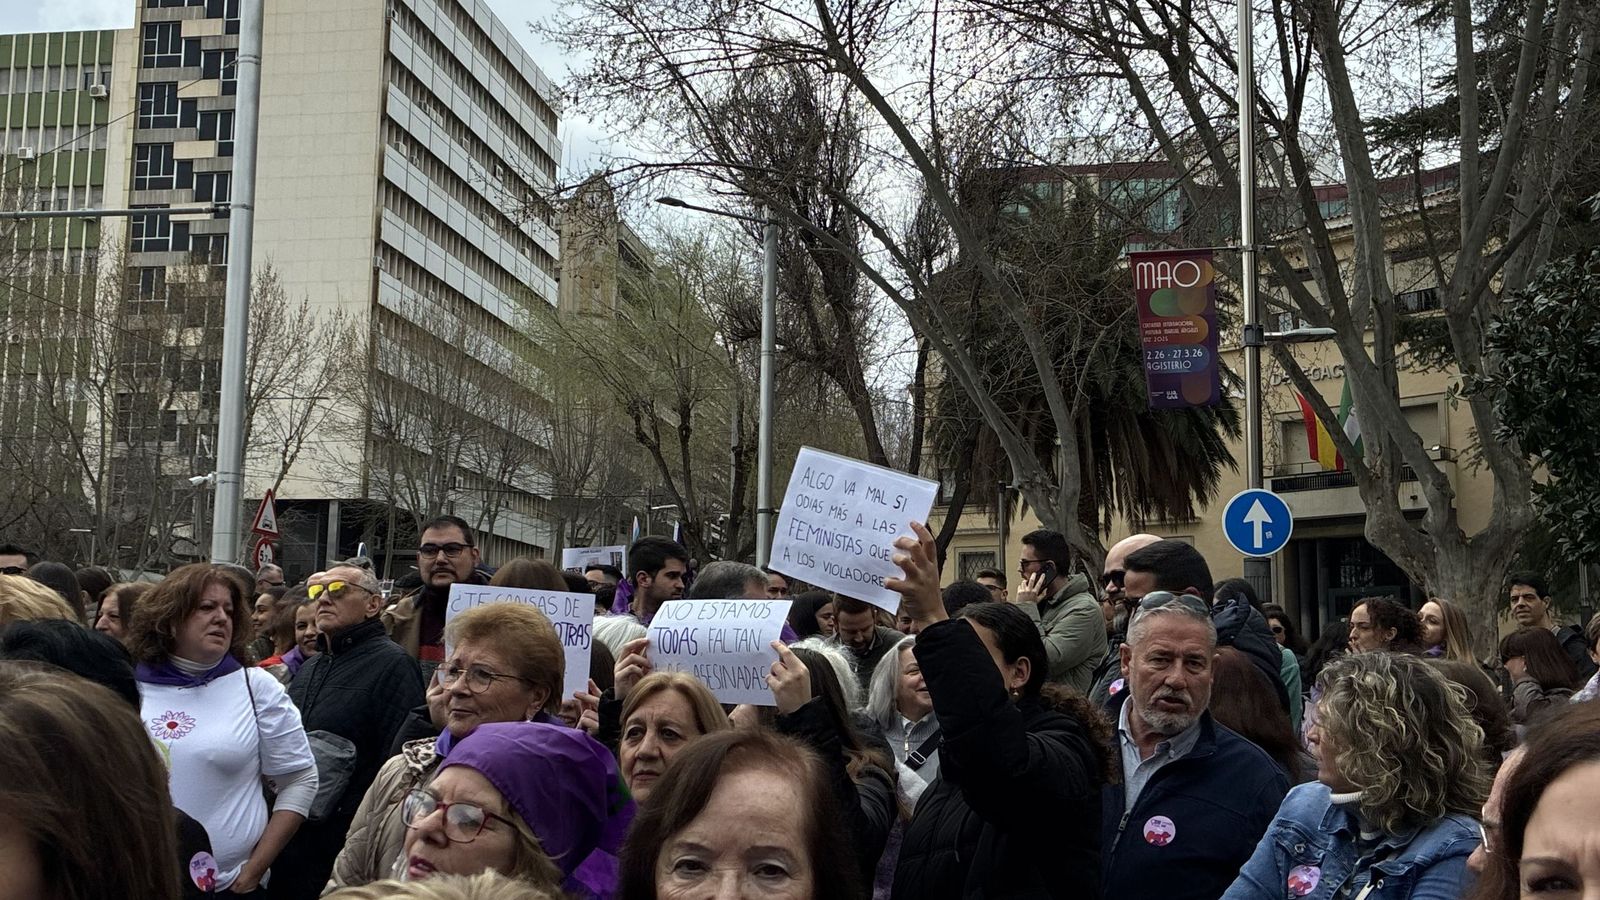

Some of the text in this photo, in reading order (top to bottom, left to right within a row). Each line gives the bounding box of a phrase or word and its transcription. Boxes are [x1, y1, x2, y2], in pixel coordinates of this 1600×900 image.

[1136, 260, 1200, 289] MAO
[1146, 360, 1192, 370] AGISTERIO
[1173, 348, 1203, 359] 27.3.26
[801, 467, 907, 512] ALGO VA MAL SI
[795, 494, 897, 535] ODIAS MÁS A LAS
[788, 517, 890, 562] FEMINISTAS QUE
[783, 547, 885, 588] A LOS VIOLADORE
[564, 597, 581, 618] DE
[660, 601, 773, 620] NO ESTAMOS
[554, 621, 591, 650] OTRAS
[708, 627, 762, 653] FALTAN
